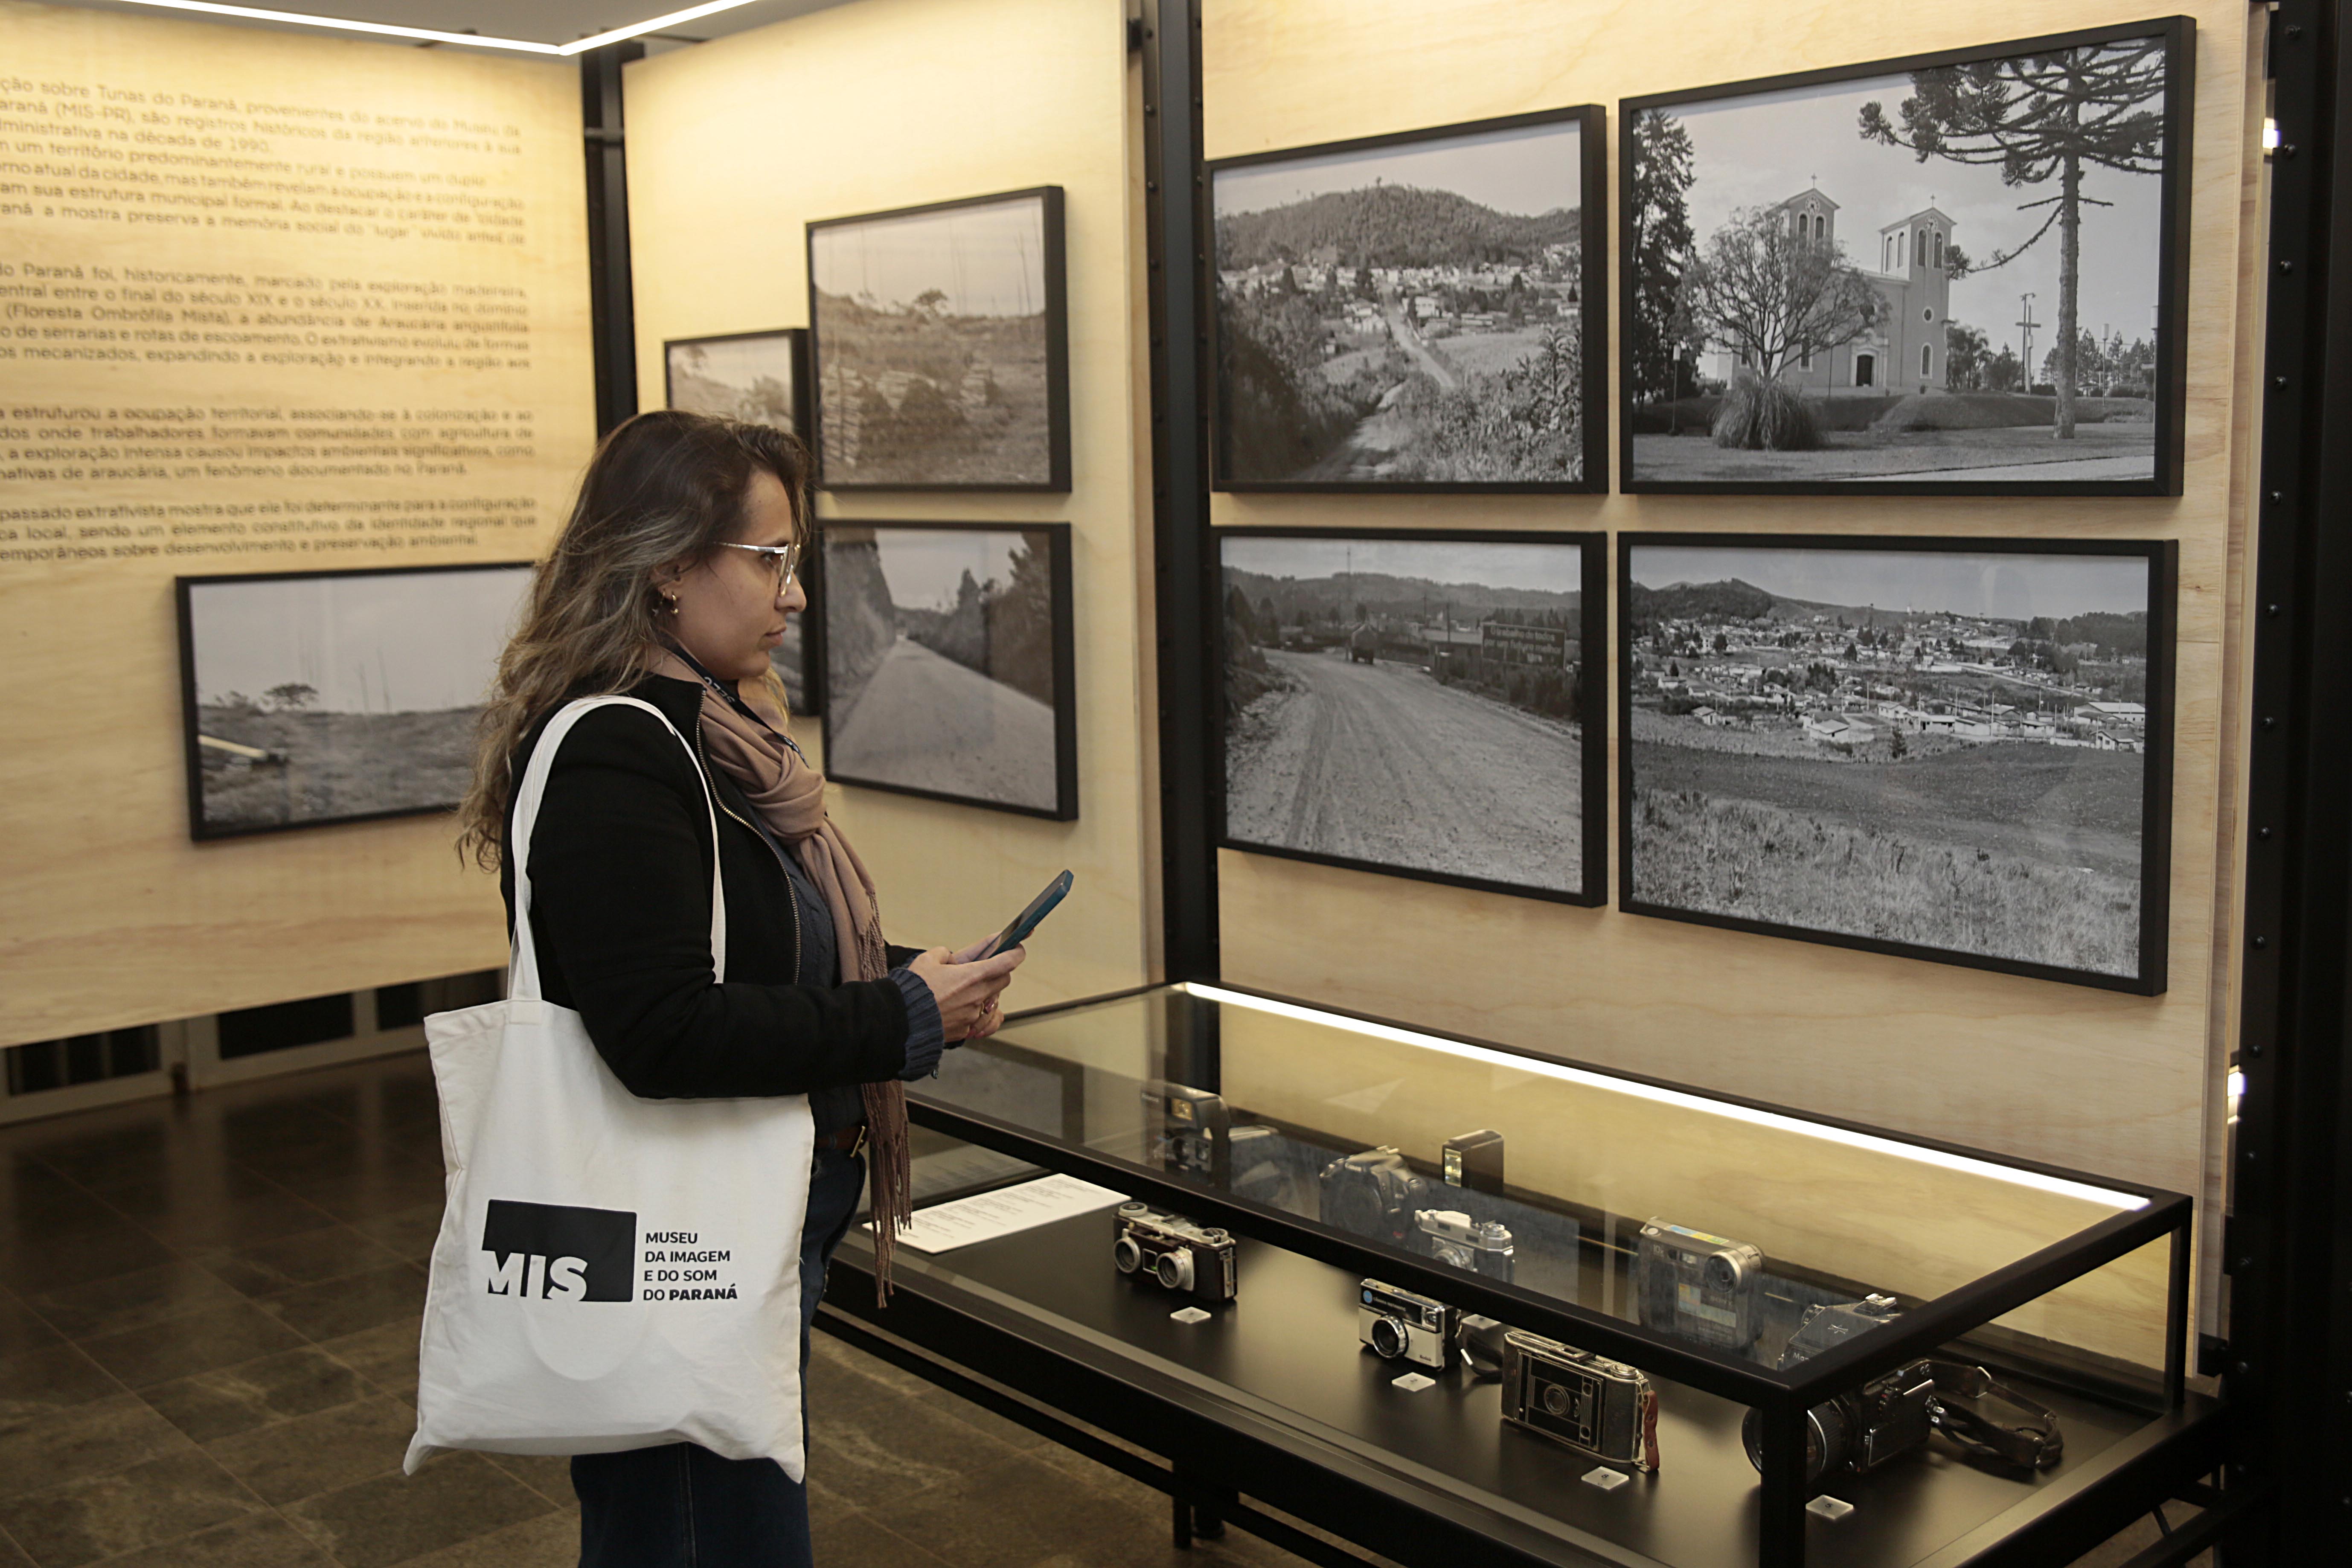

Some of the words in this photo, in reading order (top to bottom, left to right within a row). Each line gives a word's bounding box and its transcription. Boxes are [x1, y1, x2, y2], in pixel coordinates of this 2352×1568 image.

[40, 81, 89, 98] sobre
[96, 83, 145, 103] Tunas
[152, 92, 174, 105] do
[141, 111, 170, 125] são
[176, 116, 246, 131] registros
[107, 129, 128, 141] na
[134, 131, 196, 146] década
[201, 137, 221, 148] de
[15, 142, 42, 152] um
[48, 142, 123, 160] território
[128, 151, 291, 173] predominantemente
[0, 161, 31, 174] rno
[33, 163, 76, 176] atual
[78, 166, 99, 179] da
[164, 174, 198, 186] mas
[32, 185, 63, 198] sua
[67, 186, 145, 202] estrutura
[150, 192, 230, 208] municipal
[0, 202, 32, 215] aná
[44, 206, 53, 216] a
[60, 206, 120, 221] mostra
[127, 211, 199, 225] preserva
[22, 262, 84, 279] Paraná
[52, 286, 98, 300] entre
[104, 289, 116, 301] o
[121, 286, 156, 302] final
[161, 289, 183, 303] do
[5, 303, 82, 319] (Floresta
[90, 305, 173, 323] Ombrófila
[0, 326, 11, 337] o
[14, 325, 37, 337] de
[42, 327, 116, 340] serrarias
[119, 330, 130, 340] e
[134, 329, 175, 342] rotas
[178, 330, 198, 342] de
[145, 349, 240, 363] expandindo
[11, 405, 101, 420] estruturou
[107, 409, 118, 419] a
[122, 407, 204, 422] ocupação
[38, 425, 81, 439] onde
[90, 426, 204, 440] trabalhadores
[8, 449, 18, 460] a
[23, 446, 118, 462] exploração
[124, 447, 182, 459] intensa
[186, 448, 243, 458] causou
[61, 467, 83, 480] de
[174, 466, 200, 479] um
[74, 505, 165, 519] extrativista
[167, 503, 224, 515] mostra
[79, 526, 131, 539] sendo
[137, 526, 164, 537] um
[171, 523, 245, 536] elemento
[112, 544, 159, 557] sobre
[646, 1232, 697, 1243] MUSEU
[645, 1251, 665, 1262] DA
[671, 1251, 730, 1262] IMAGEM
[481, 1250, 589, 1302] MIS
[645, 1271, 653, 1281] E
[658, 1270, 678, 1281] DO
[684, 1270, 716, 1281] SOM
[644, 1289, 664, 1300] DO
[670, 1283, 737, 1300] PARANÁ
